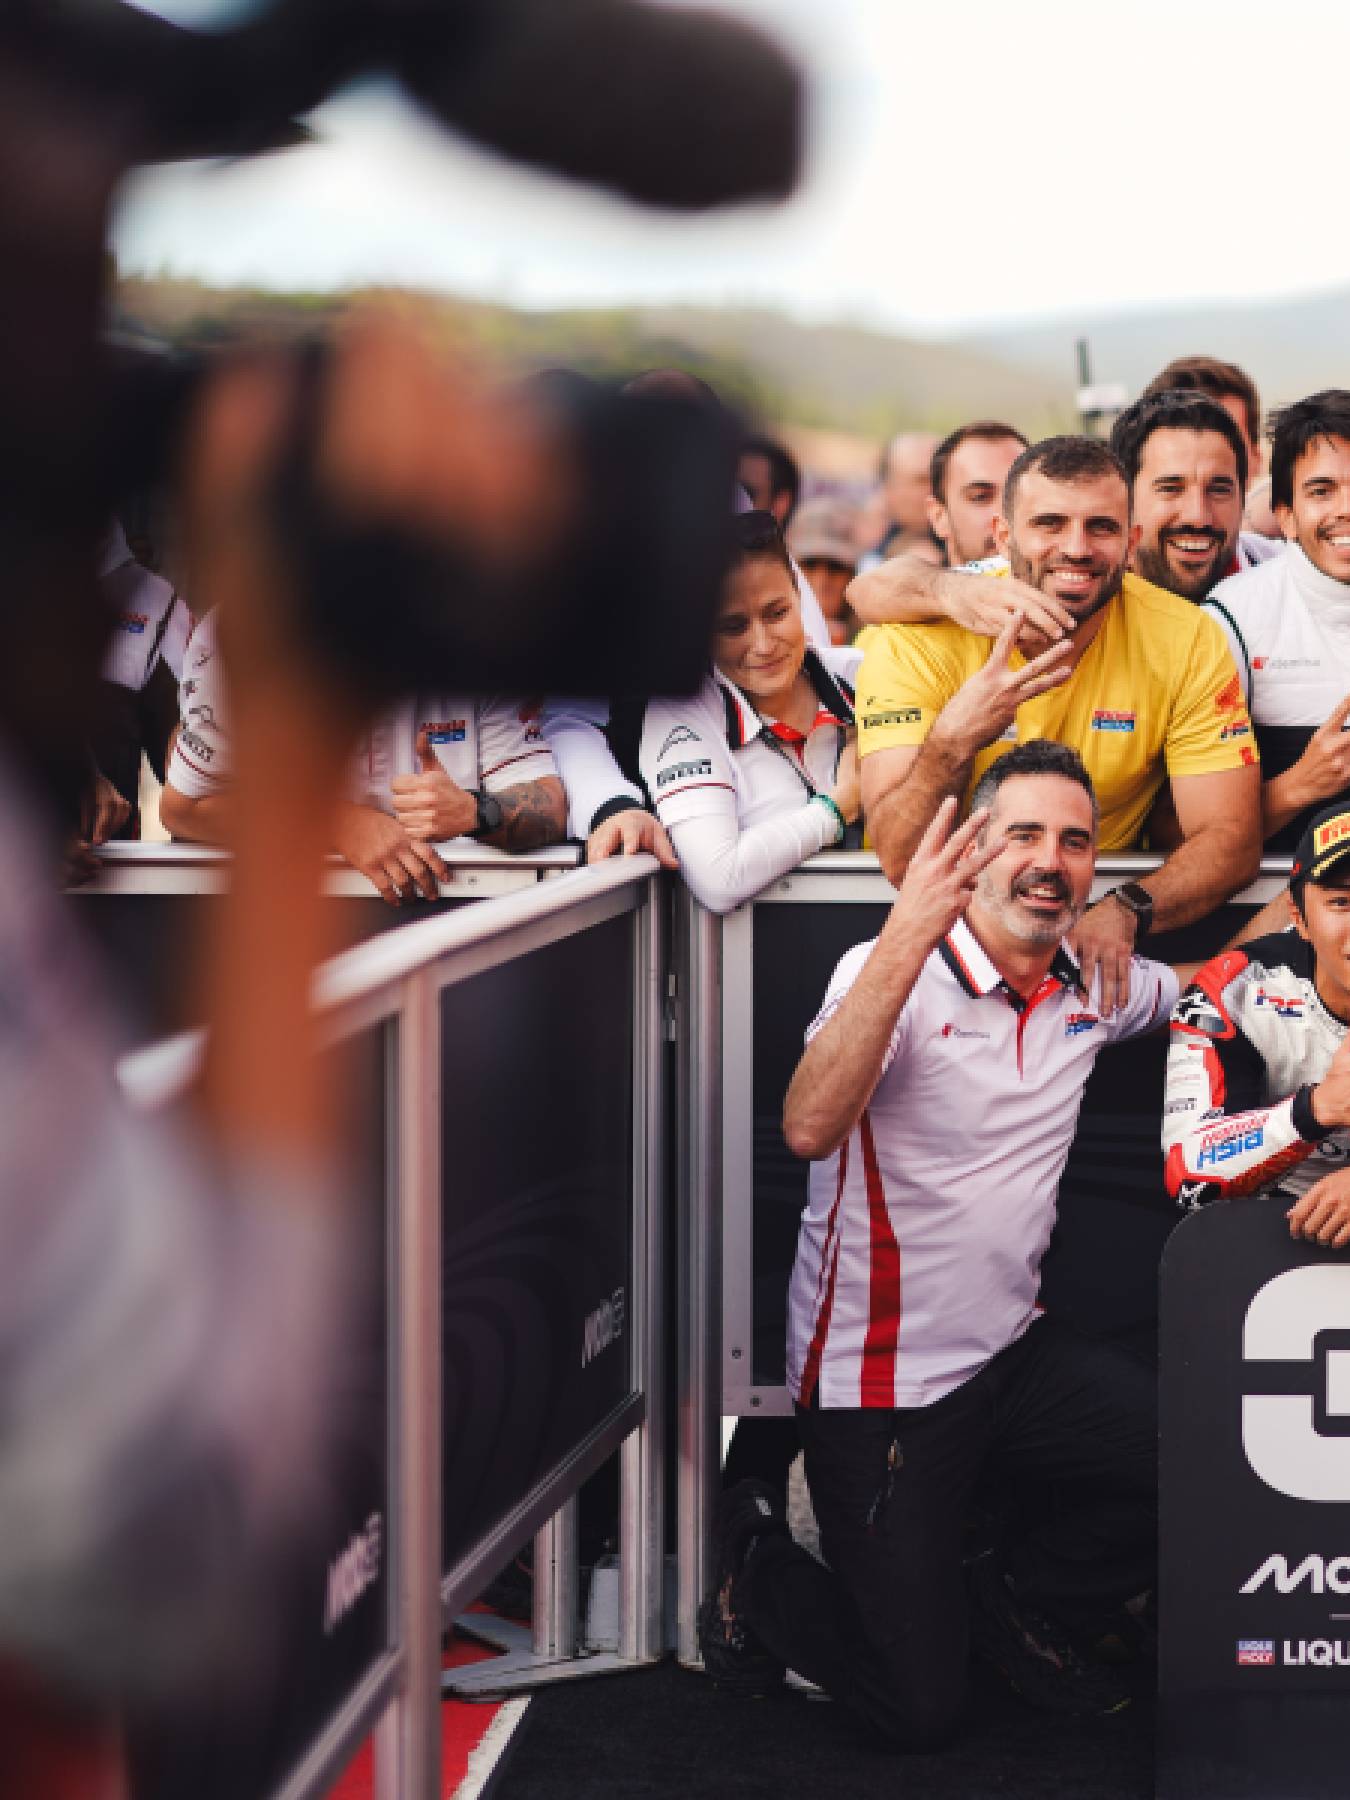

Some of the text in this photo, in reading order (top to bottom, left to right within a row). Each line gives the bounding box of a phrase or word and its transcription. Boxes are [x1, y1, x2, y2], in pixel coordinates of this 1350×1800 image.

[656, 758, 712, 788] PIRELLI
[1255, 986, 1306, 1018] HRC
[1201, 1113, 1269, 1150] Honda
